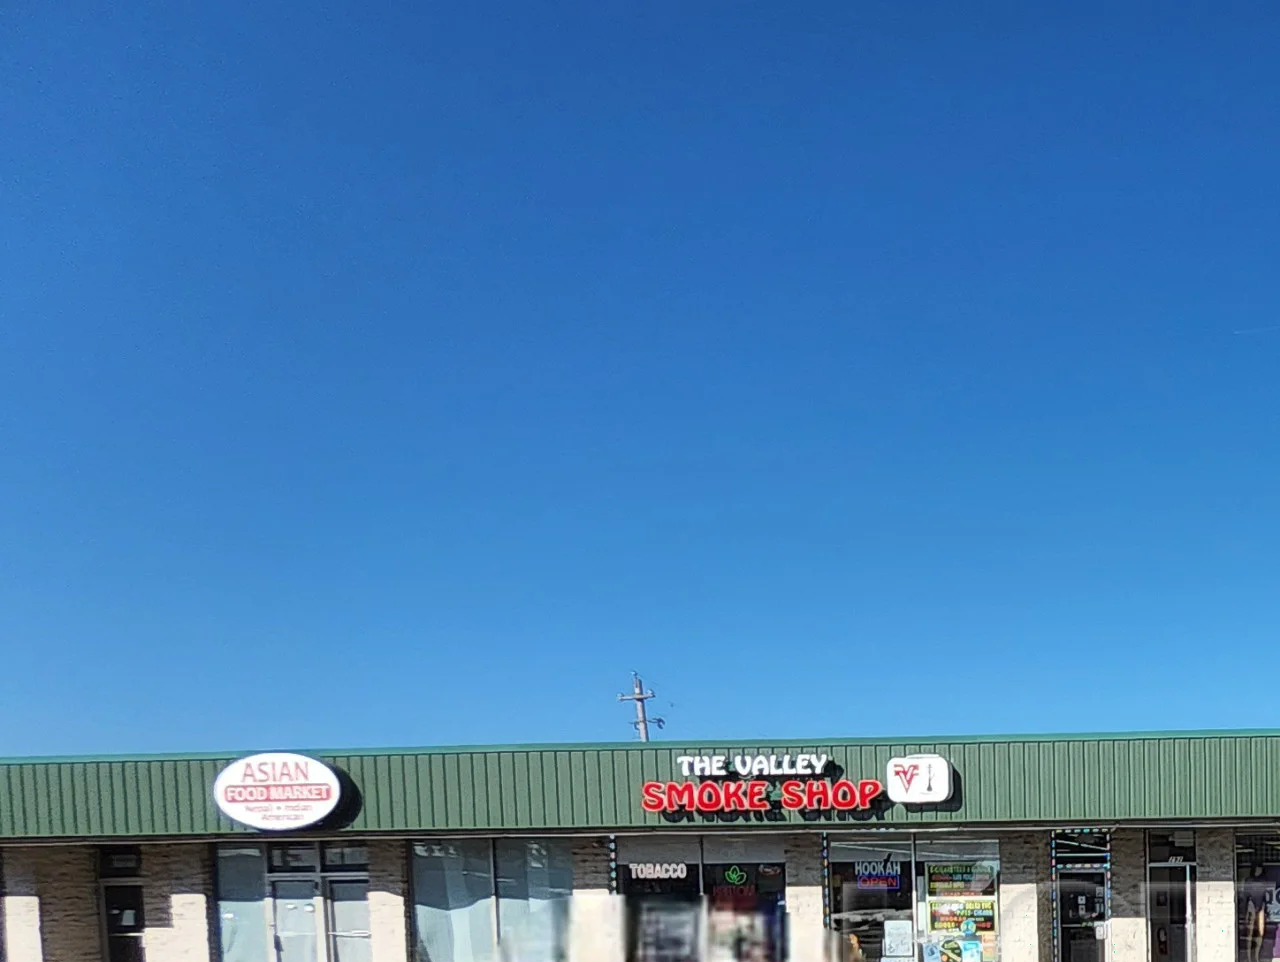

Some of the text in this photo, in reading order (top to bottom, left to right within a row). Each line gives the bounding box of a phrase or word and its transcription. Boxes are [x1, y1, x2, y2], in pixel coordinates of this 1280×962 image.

[241, 761, 309, 782] ASIAN
[677, 754, 828, 776] THE VALLEY
[227, 785, 330, 801] FOOD MARKET
[642, 779, 883, 812] SMOKE SHOP
[629, 863, 687, 879] TOBACCO
[855, 861, 901, 876] HOOKAH
[860, 877, 897, 887] OPEN
